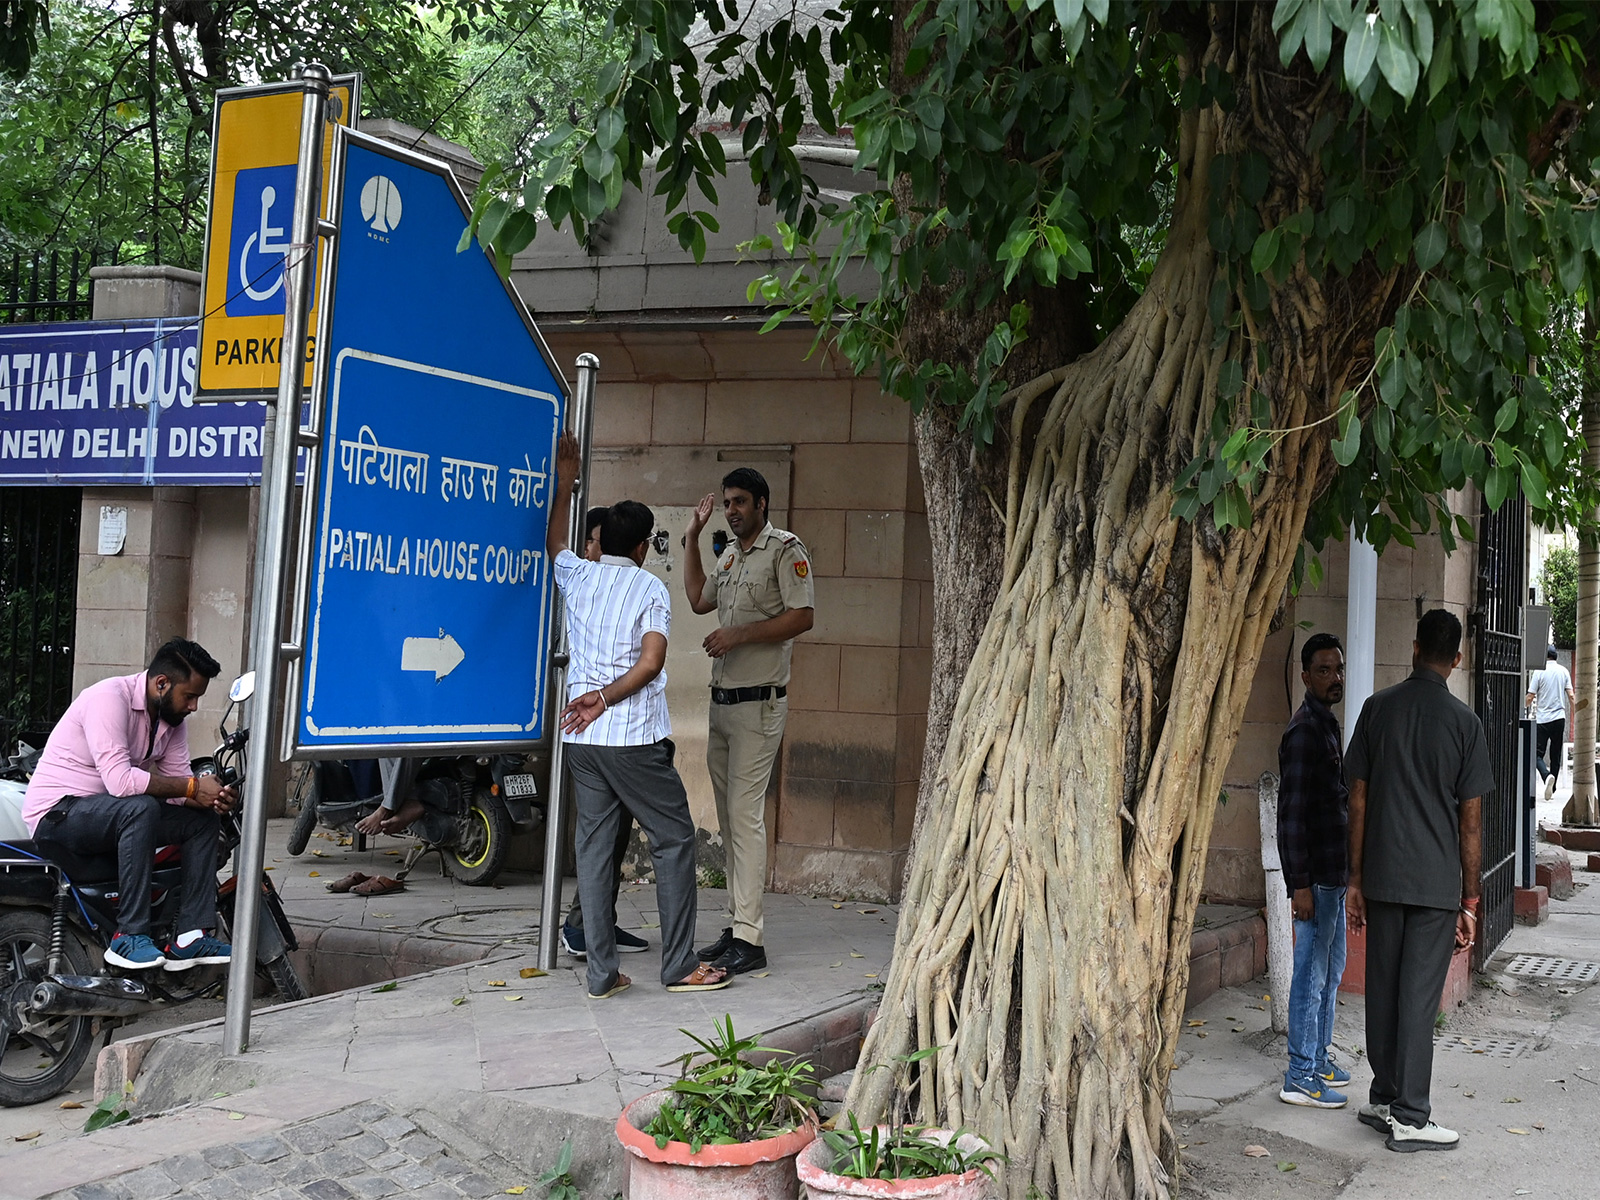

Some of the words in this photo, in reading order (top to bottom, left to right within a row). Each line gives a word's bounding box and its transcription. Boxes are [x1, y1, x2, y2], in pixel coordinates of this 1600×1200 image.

[215, 335, 316, 366] PARKIG
[109, 346, 218, 409] HOUS
[72, 427, 159, 459] DELHI
[168, 425, 308, 458] DISTR
[340, 424, 429, 494] पटियाला
[441, 456, 499, 503] हाउस
[508, 453, 547, 508] कोर्ट
[329, 528, 410, 577] PATIALA
[415, 538, 479, 581] HOUSE
